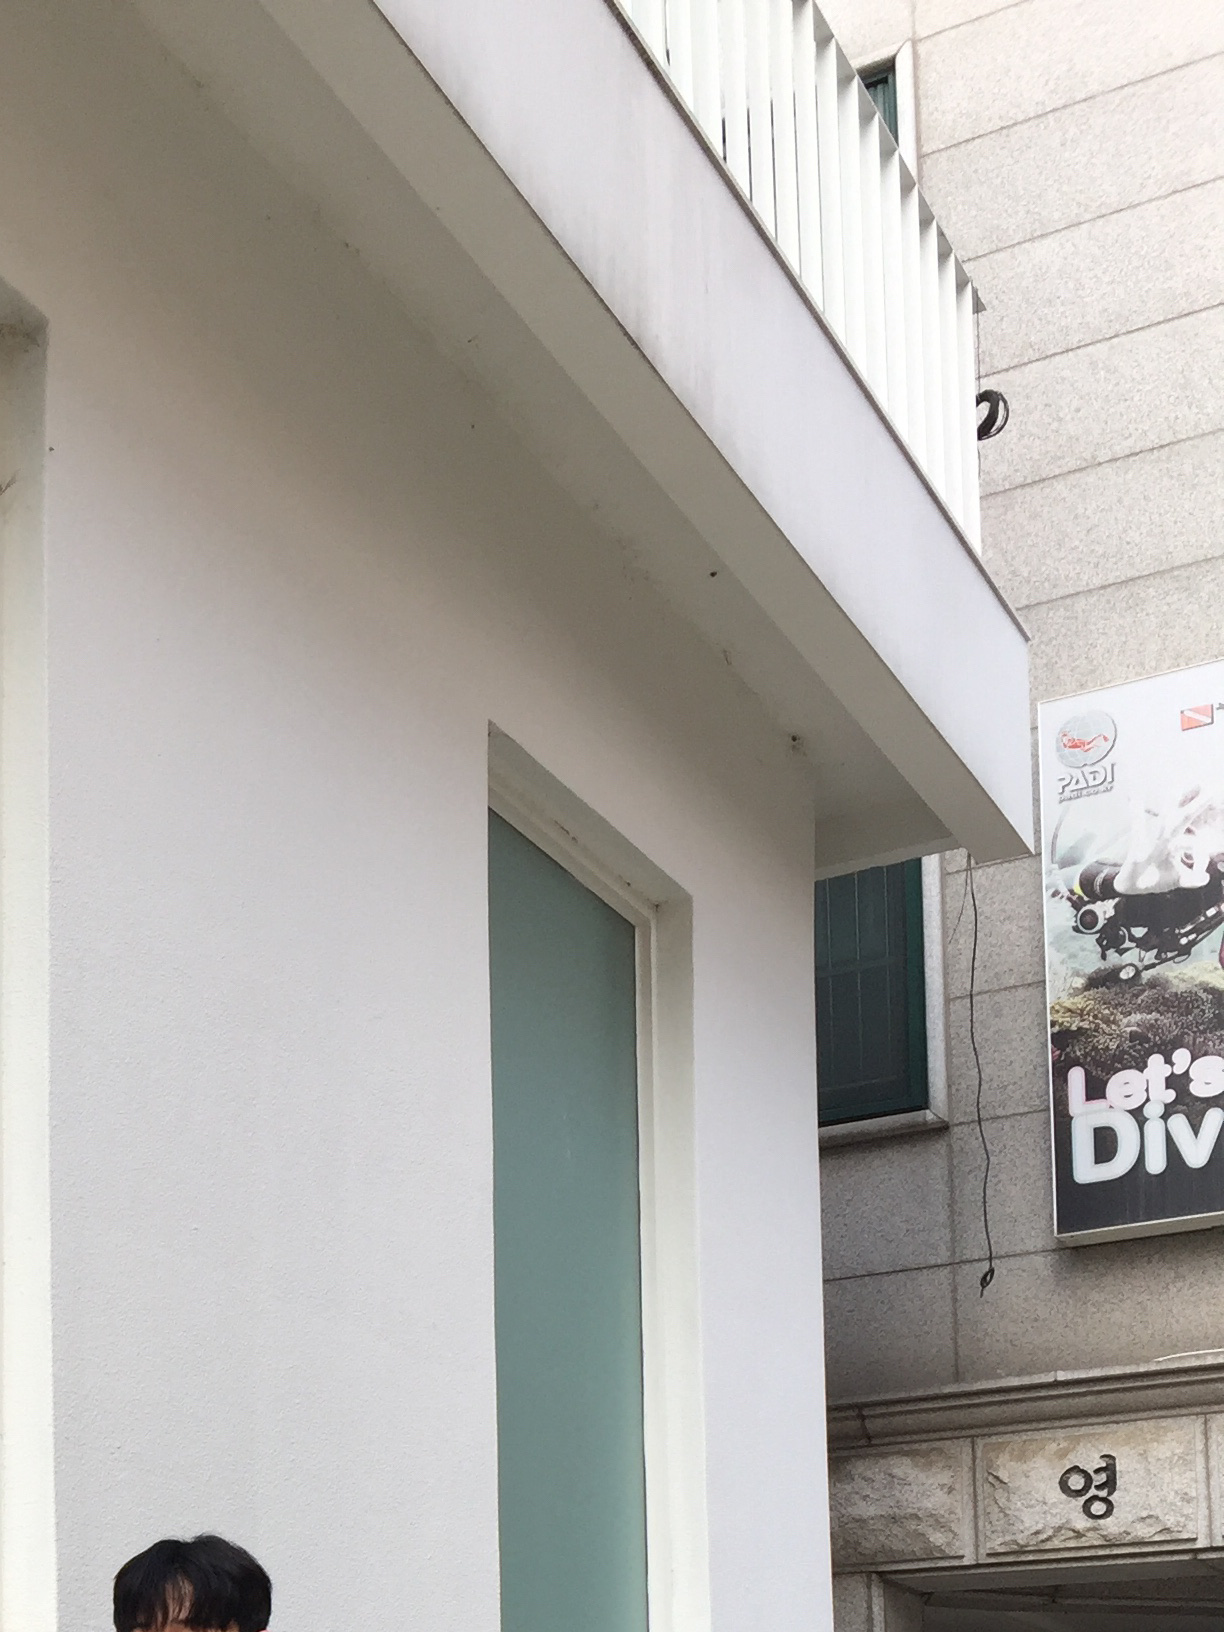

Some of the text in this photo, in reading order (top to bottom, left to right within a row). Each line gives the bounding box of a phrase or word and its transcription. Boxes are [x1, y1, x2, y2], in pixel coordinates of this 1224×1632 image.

[1057, 763, 1116, 796] PADI
[1068, 1048, 1224, 1117] Let's
[1058, 1454, 1117, 1520] 영
